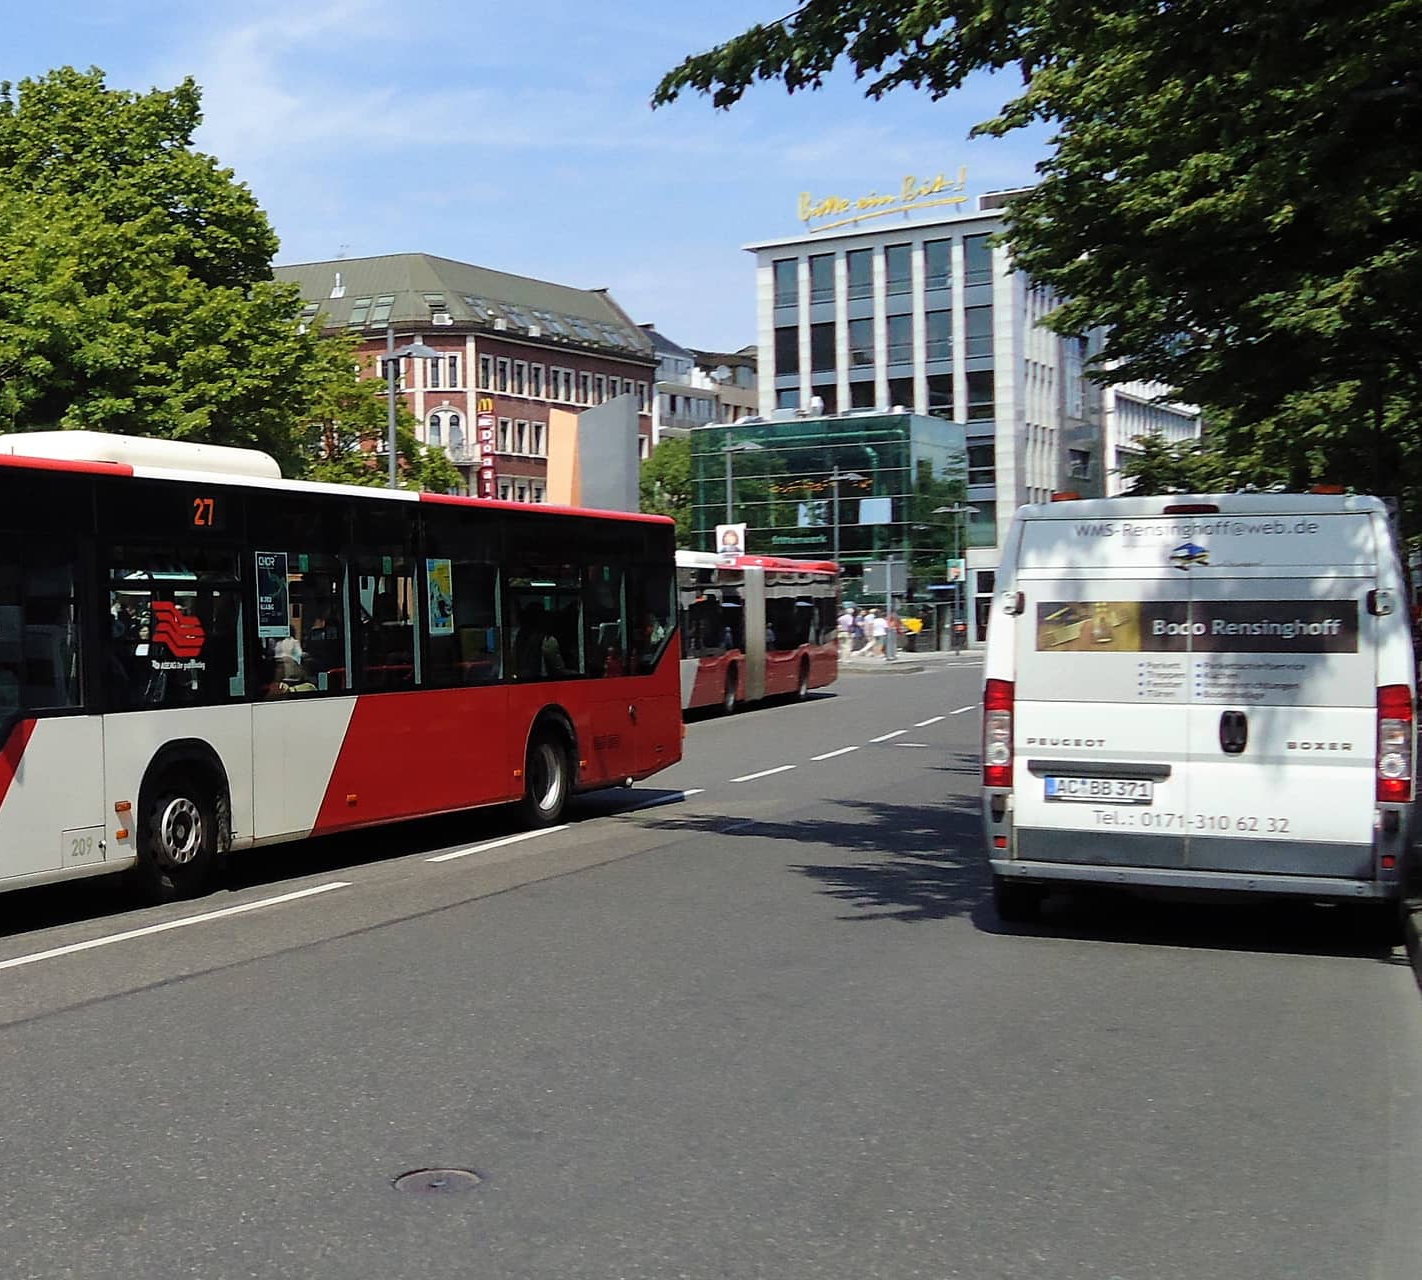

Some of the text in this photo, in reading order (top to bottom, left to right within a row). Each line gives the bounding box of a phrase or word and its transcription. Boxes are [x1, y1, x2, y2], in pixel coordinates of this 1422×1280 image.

[799, 192, 849, 222] Bitte
[856, 192, 894, 209] ein
[193, 498, 215, 526] 27
[1075, 519, 1320, 539] WMS-Rensinghoff@web.de
[1210, 618, 1342, 639] Rensinghoff
[1026, 737, 1106, 747] PEUGEOT
[1286, 741, 1353, 752] BOXER
[1057, 779, 1149, 797] AC BB 371
[1141, 811, 1231, 831] 0171-310
[1235, 816, 1259, 832] 62
[1266, 817, 1290, 834] 32
[71, 836, 94, 857] 209
